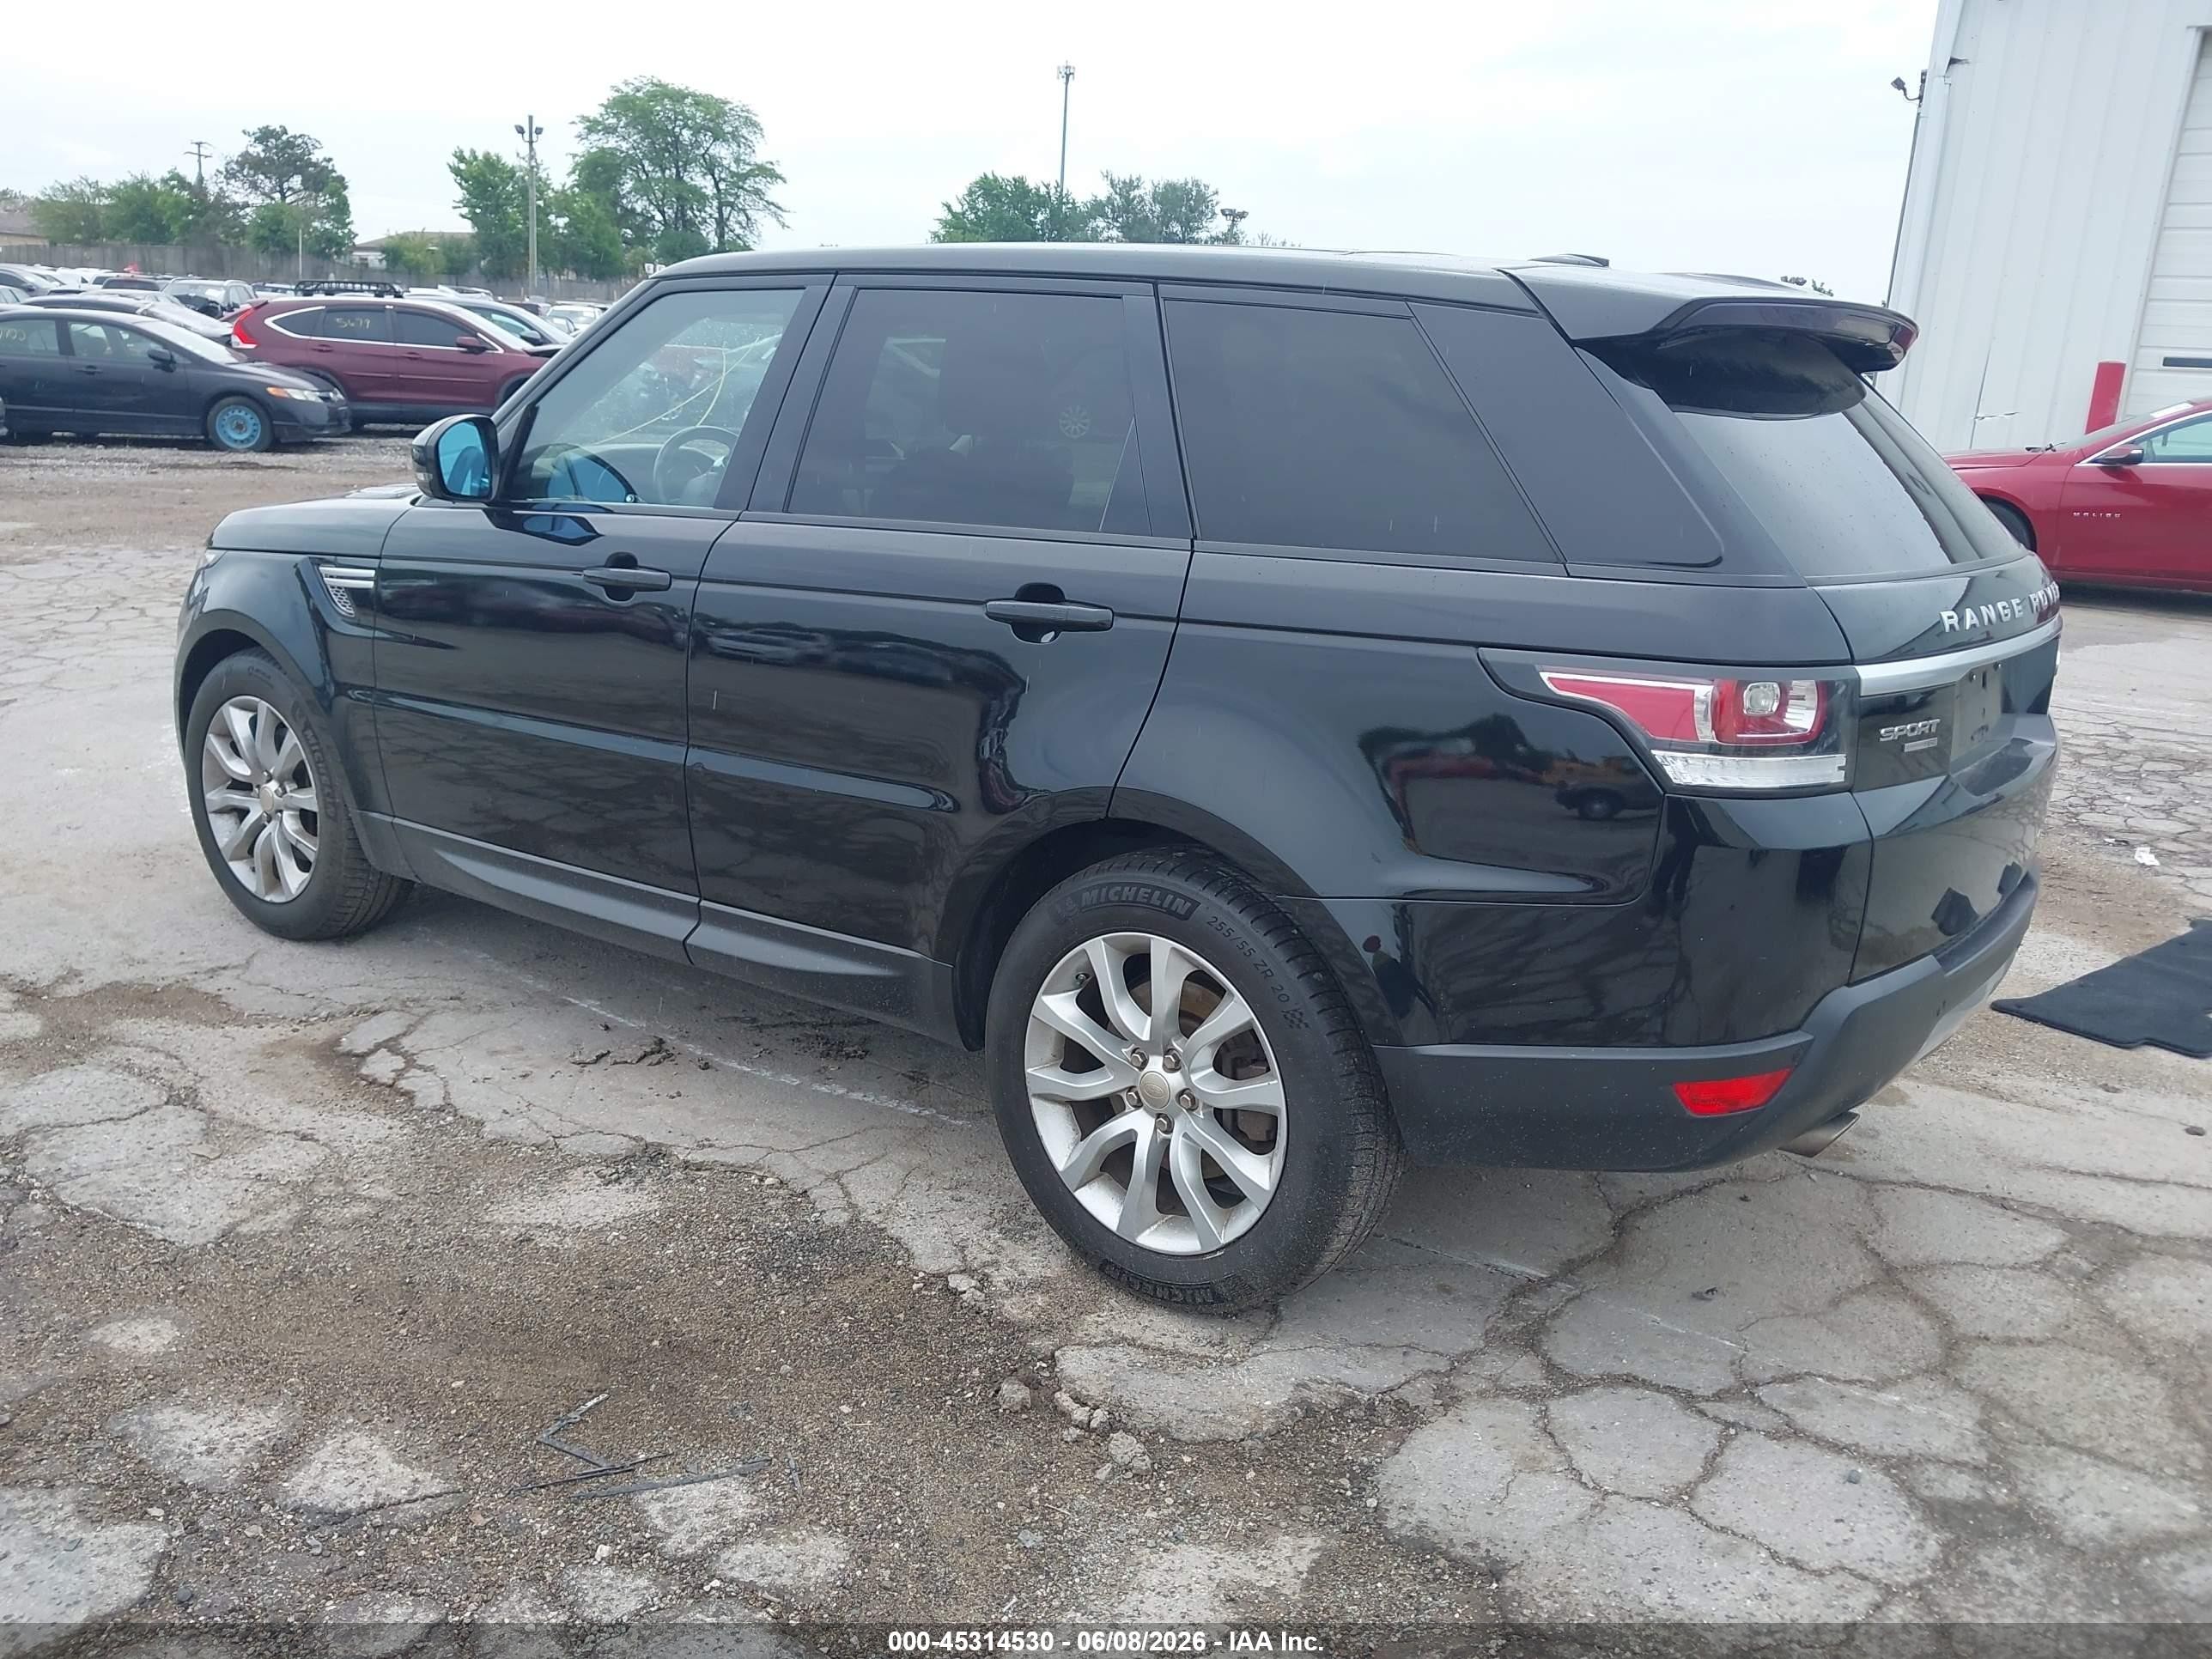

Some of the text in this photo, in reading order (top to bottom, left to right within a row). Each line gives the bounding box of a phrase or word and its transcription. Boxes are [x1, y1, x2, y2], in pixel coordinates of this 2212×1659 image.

[1940, 598, 2023, 633] RANGE
[1879, 718, 1941, 741] SPORT
[1080, 885, 1192, 915] MICHELIN
[1206, 915, 1290, 1003] 255/55 ZR 20
